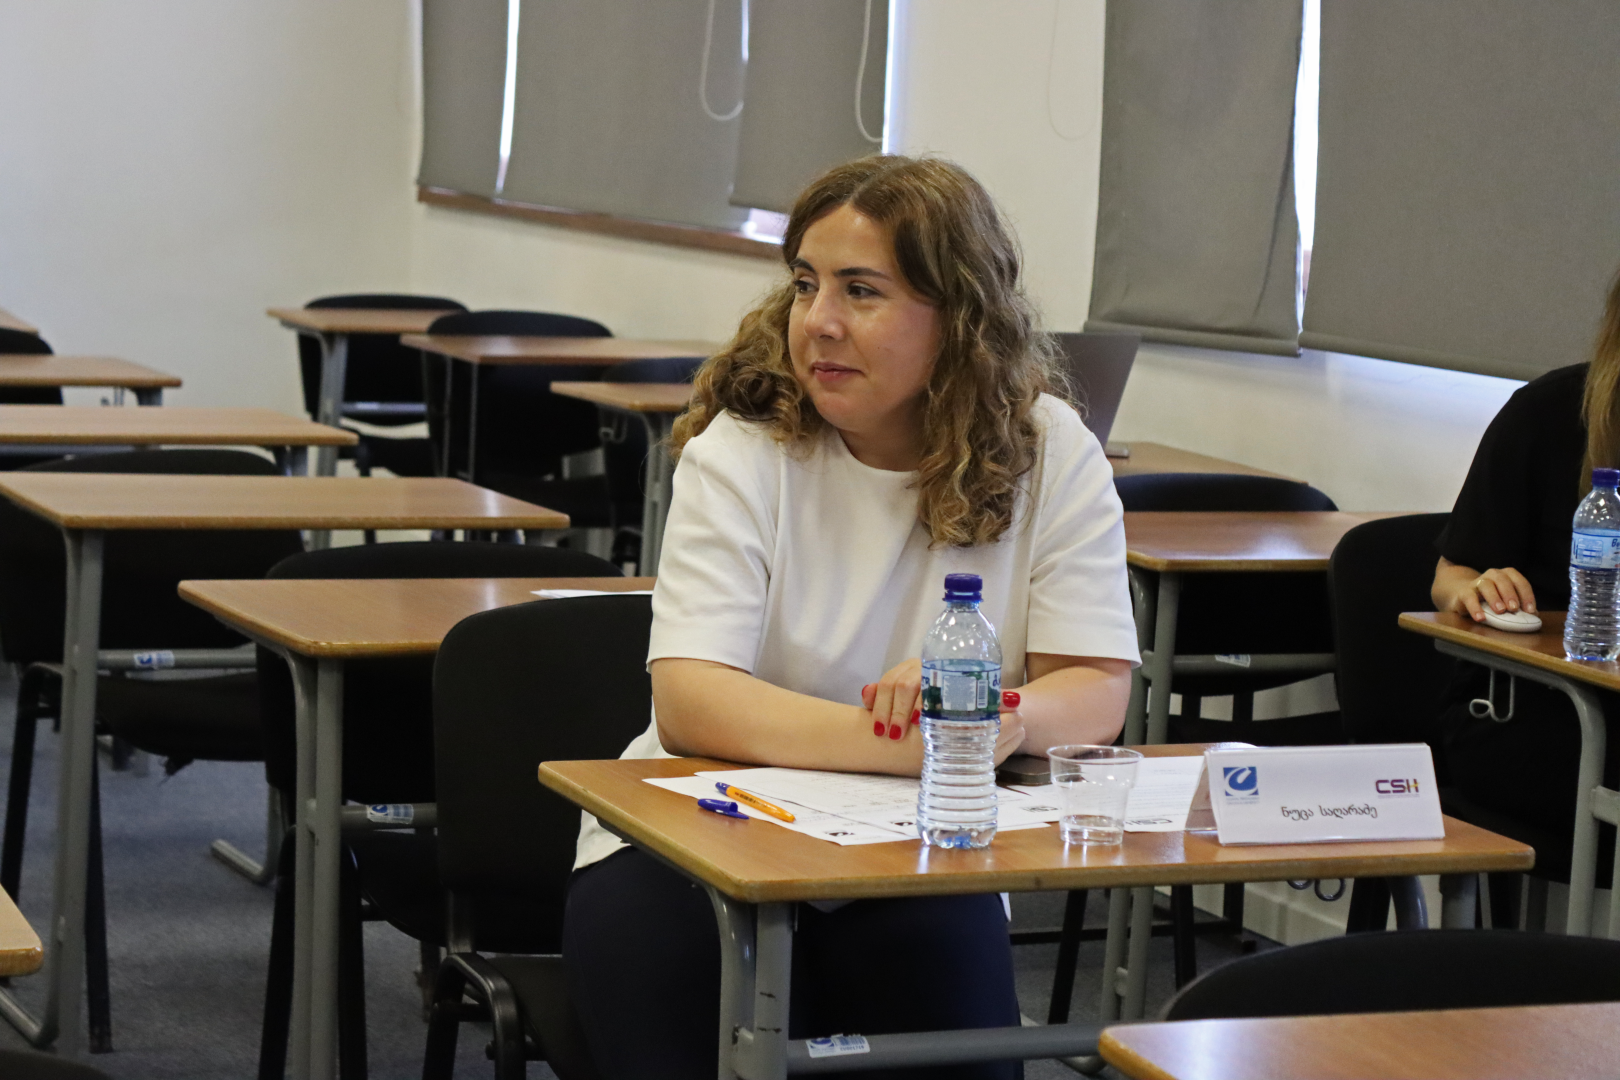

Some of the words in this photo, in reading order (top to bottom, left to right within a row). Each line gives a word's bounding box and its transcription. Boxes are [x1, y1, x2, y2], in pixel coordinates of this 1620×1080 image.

[1375, 778, 1419, 794] CSH
[1280, 806, 1314, 821] ნუცა
[1318, 803, 1378, 819] საღარაძე
